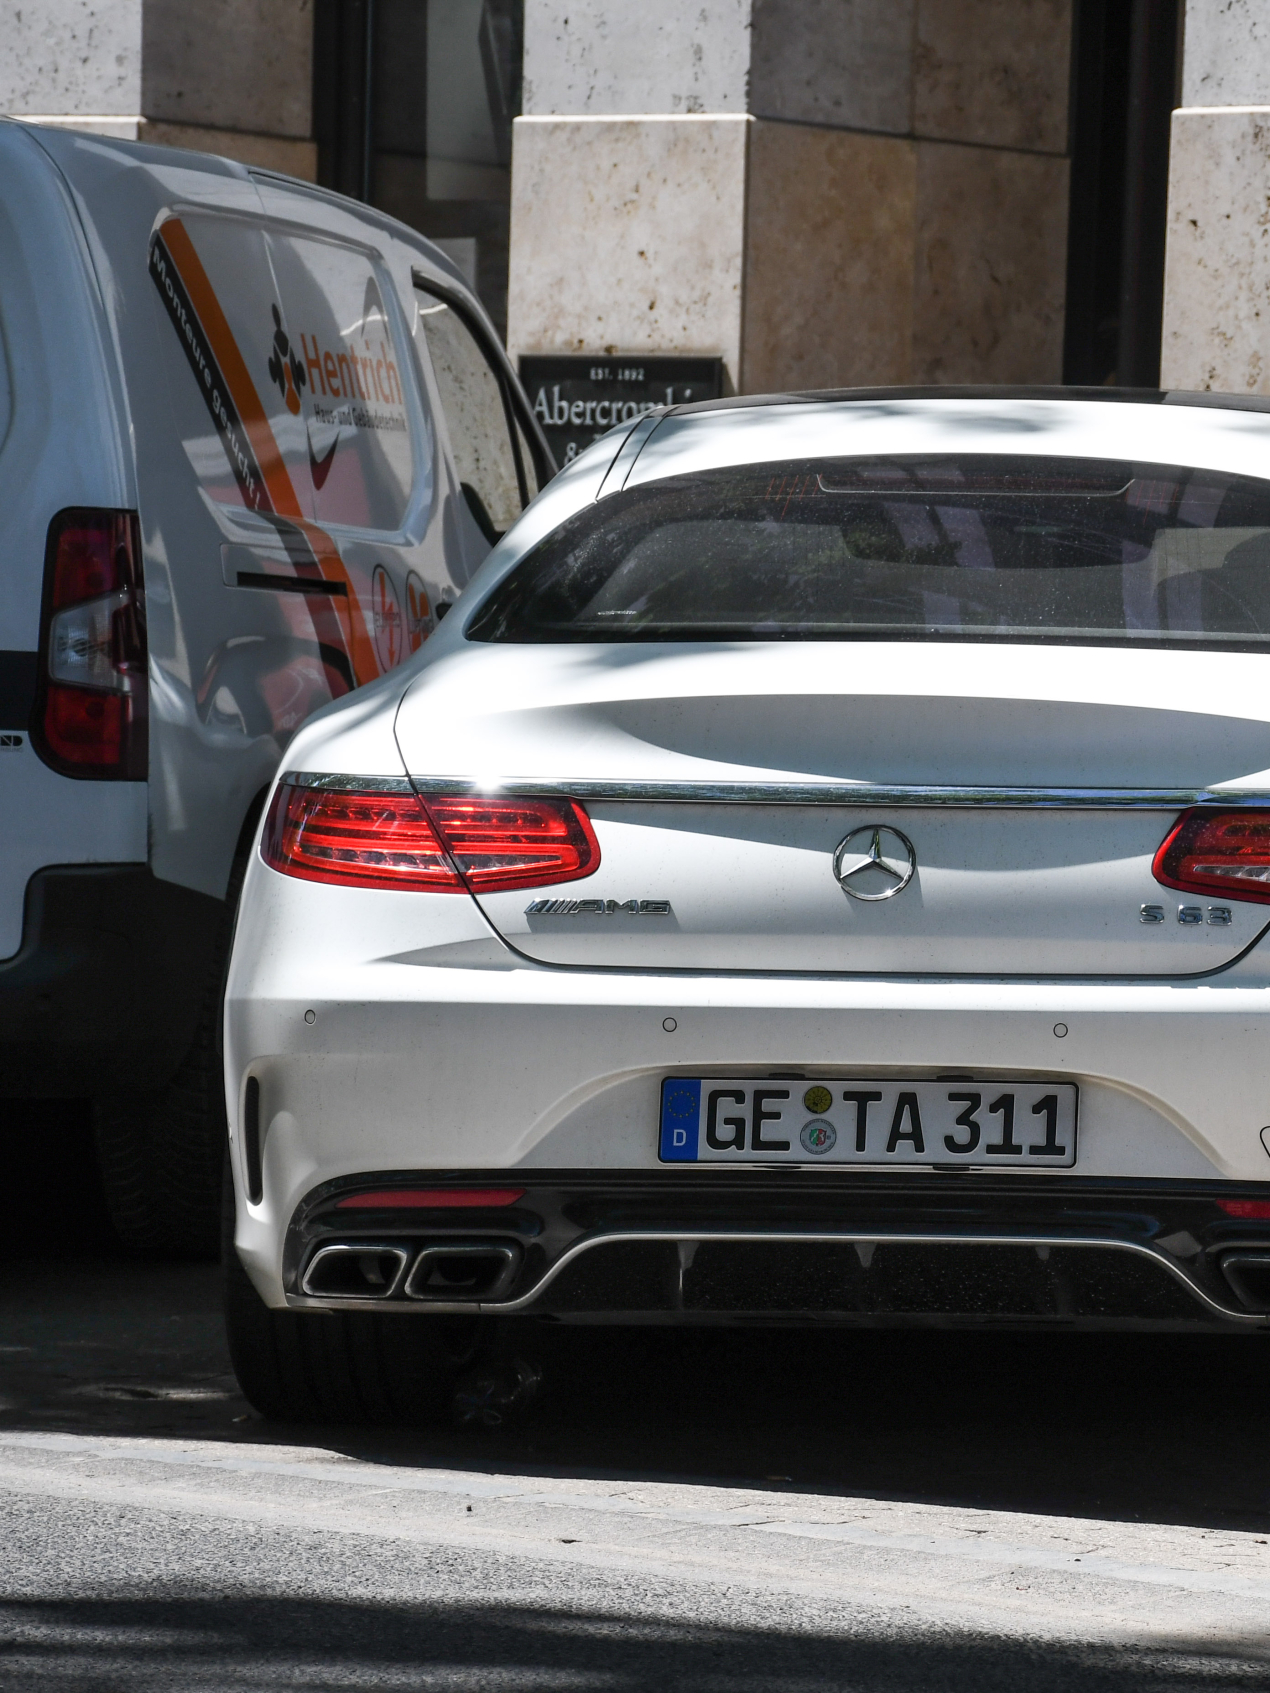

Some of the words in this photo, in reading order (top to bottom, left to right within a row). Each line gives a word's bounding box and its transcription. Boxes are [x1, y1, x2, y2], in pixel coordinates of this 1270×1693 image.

[153, 247, 212, 386] Monteure
[211, 387, 255, 498] gesucht
[300, 332, 403, 405] Hentrich
[590, 367, 613, 380] EST.
[617, 367, 645, 381] 1892
[569, 898, 671, 915] AMG
[1139, 903, 1165, 924] S
[1177, 904, 1233, 926] 63
[706, 1089, 791, 1152] GE
[842, 1090, 927, 1154] TA
[943, 1092, 1067, 1156] 311
[672, 1129, 687, 1147] D
